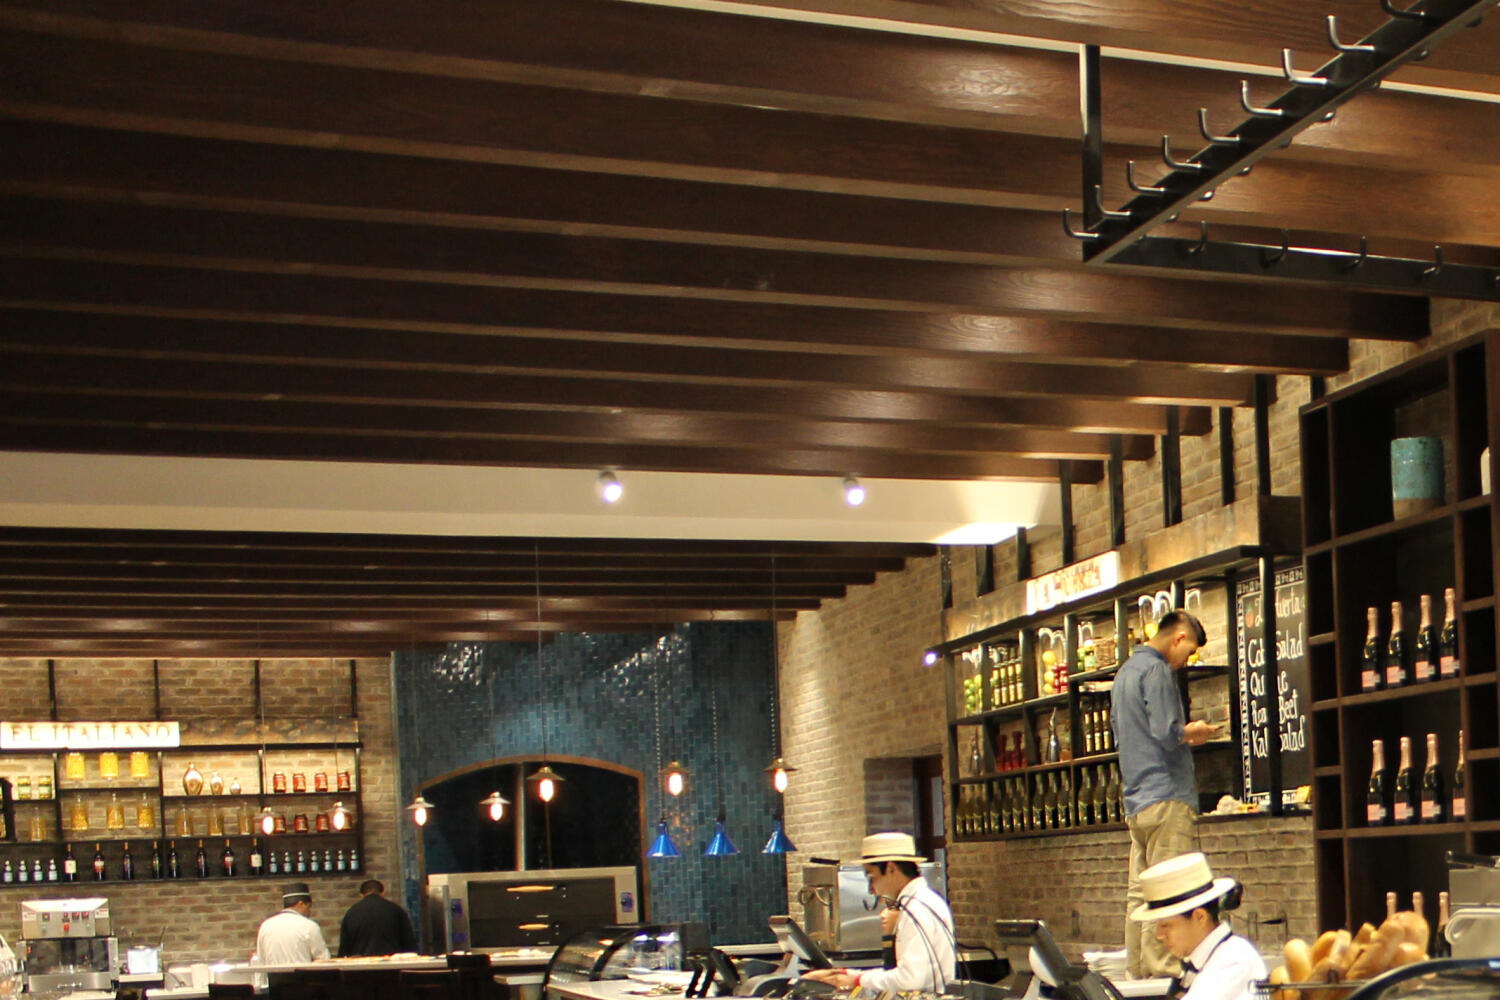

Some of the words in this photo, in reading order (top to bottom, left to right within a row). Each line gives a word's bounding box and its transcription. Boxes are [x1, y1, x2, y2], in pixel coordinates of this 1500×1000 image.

[10, 725, 40, 742] EL
[52, 724, 171, 742] ITALIANO
[1252, 726, 1268, 759] Kal
